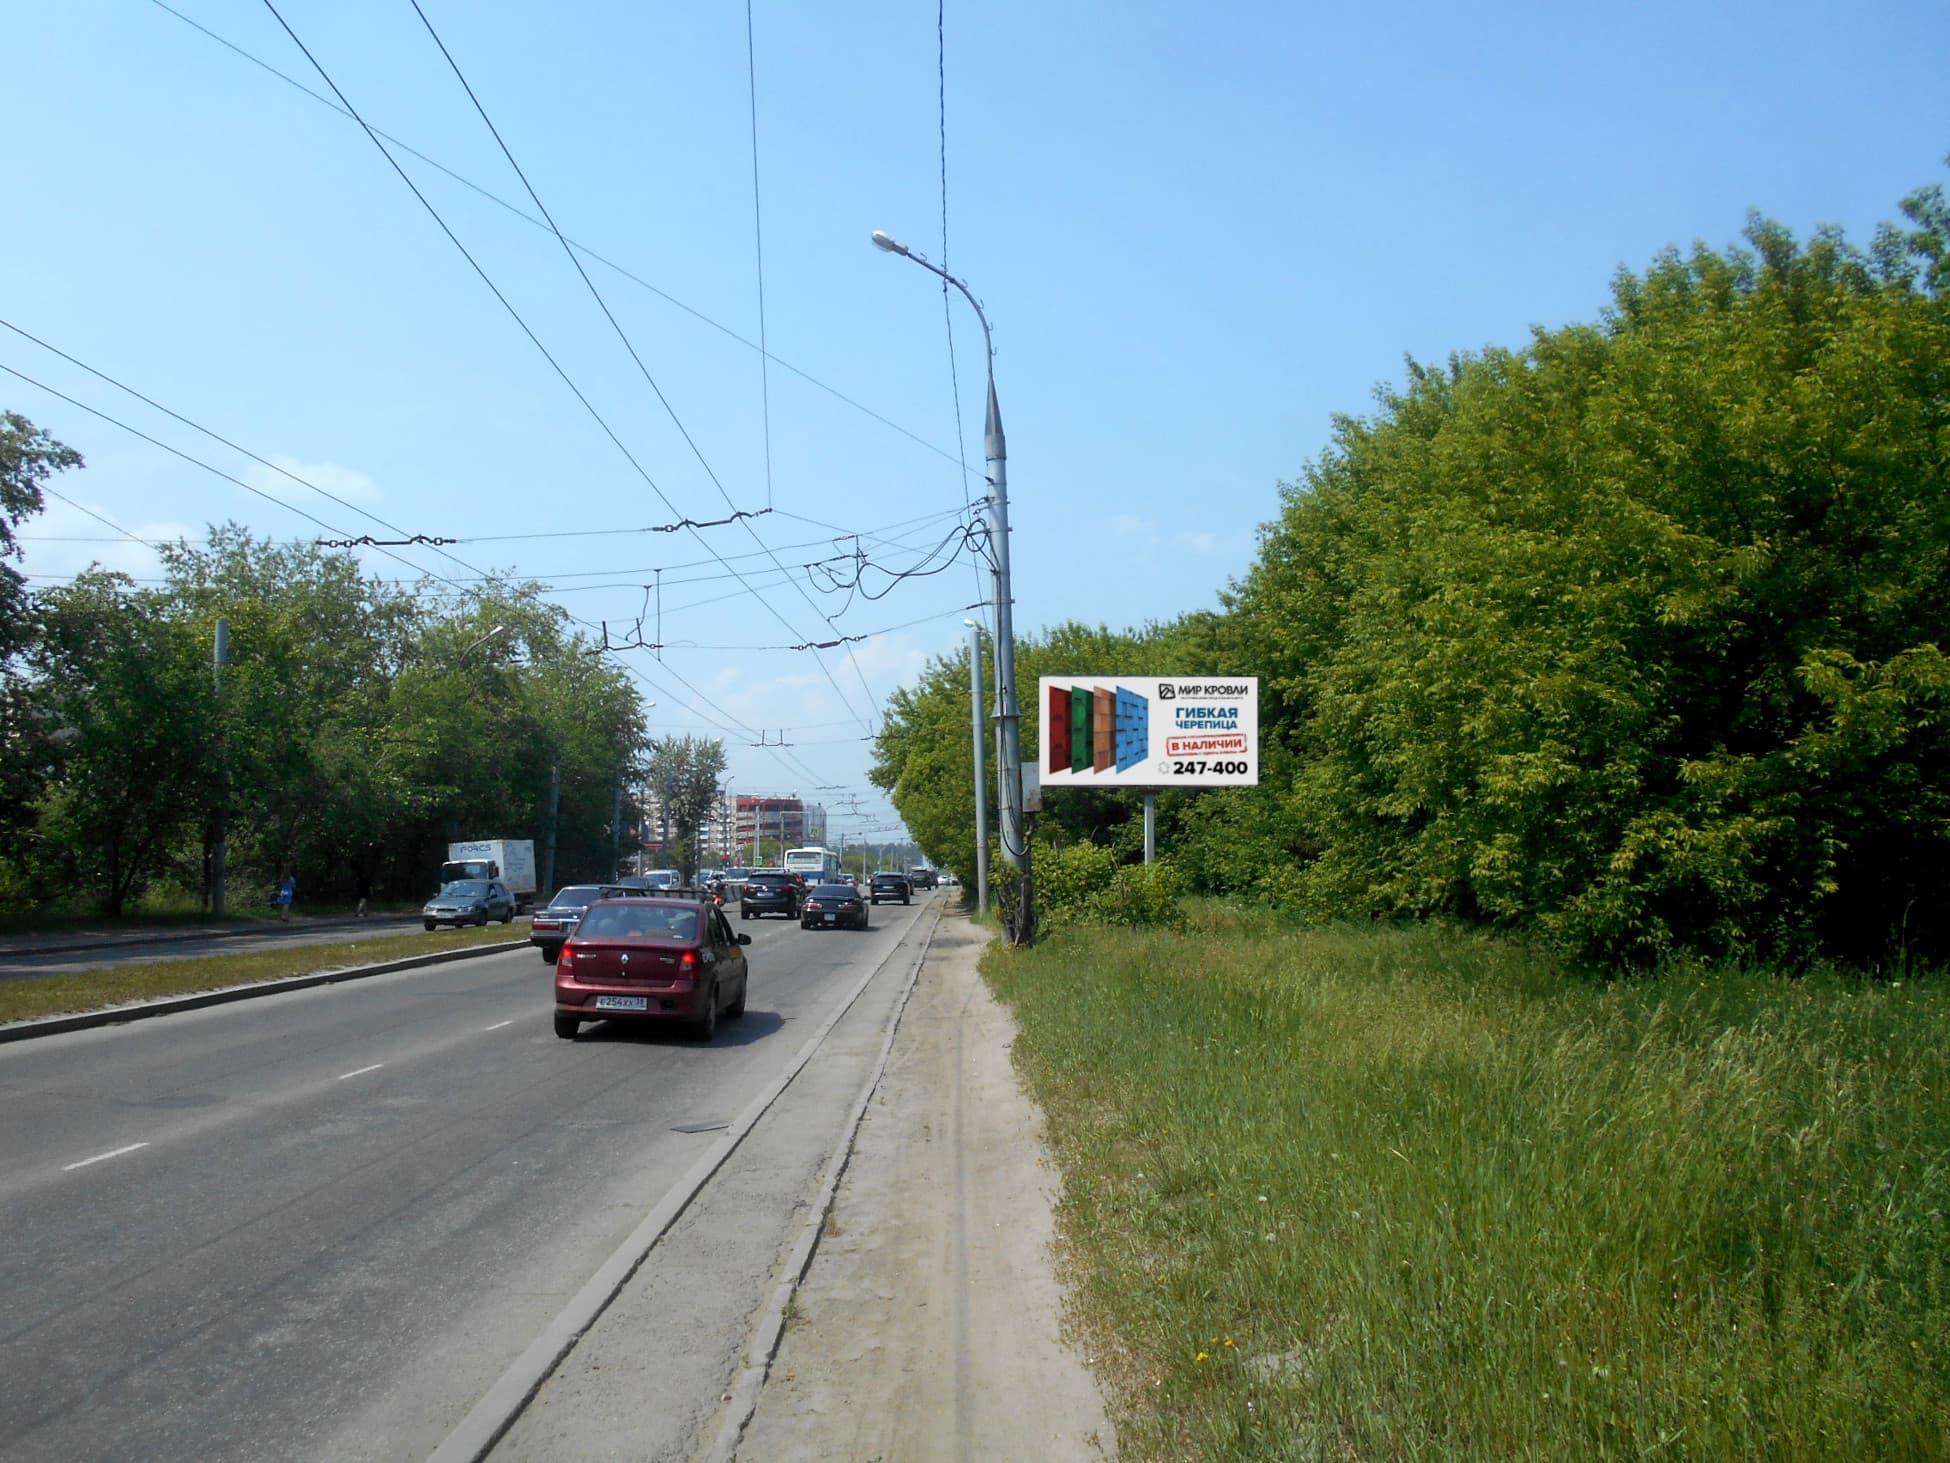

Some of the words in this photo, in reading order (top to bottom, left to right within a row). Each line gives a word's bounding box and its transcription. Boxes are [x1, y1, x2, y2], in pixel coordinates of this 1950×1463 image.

[1178, 685, 1202, 695] МИР
[1204, 685, 1248, 695] КРОВЛИ
[1175, 707, 1238, 718] ГИБКАЯ
[1175, 720, 1238, 730] ЧЕРЕПИЦА
[1171, 742, 1179, 751] В
[1182, 738, 1242, 751] НАЛИЧИИ
[1173, 761, 1248, 775] 247-400
